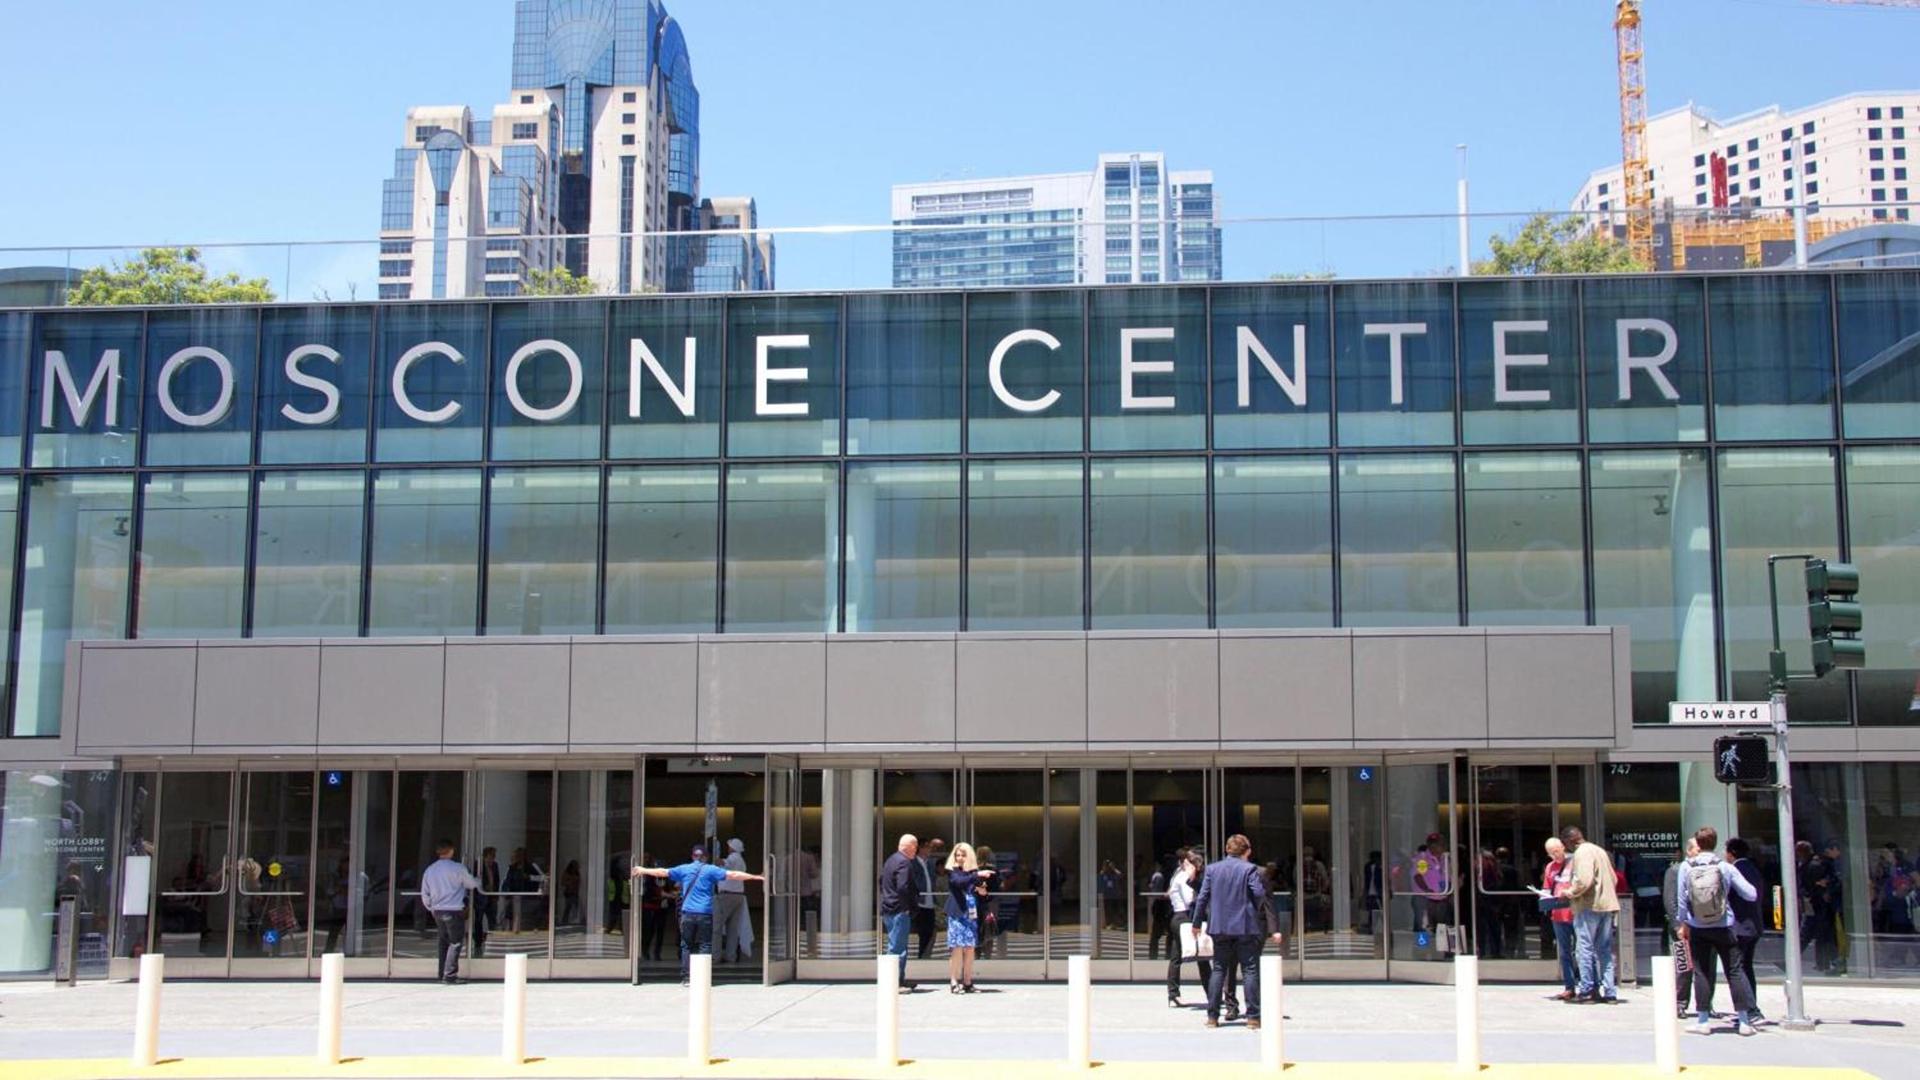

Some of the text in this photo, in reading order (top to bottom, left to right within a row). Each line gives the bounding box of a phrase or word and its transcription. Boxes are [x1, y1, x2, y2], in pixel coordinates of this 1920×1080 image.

[41, 318, 1681, 428] MOSCONE CENTER
[1684, 707, 1758, 719] Howard
[1609, 764, 1631, 774] 747
[45, 838, 75, 846] NORTH
[1612, 833, 1645, 841] NORTH
[1674, 942, 1687, 970] 2020
